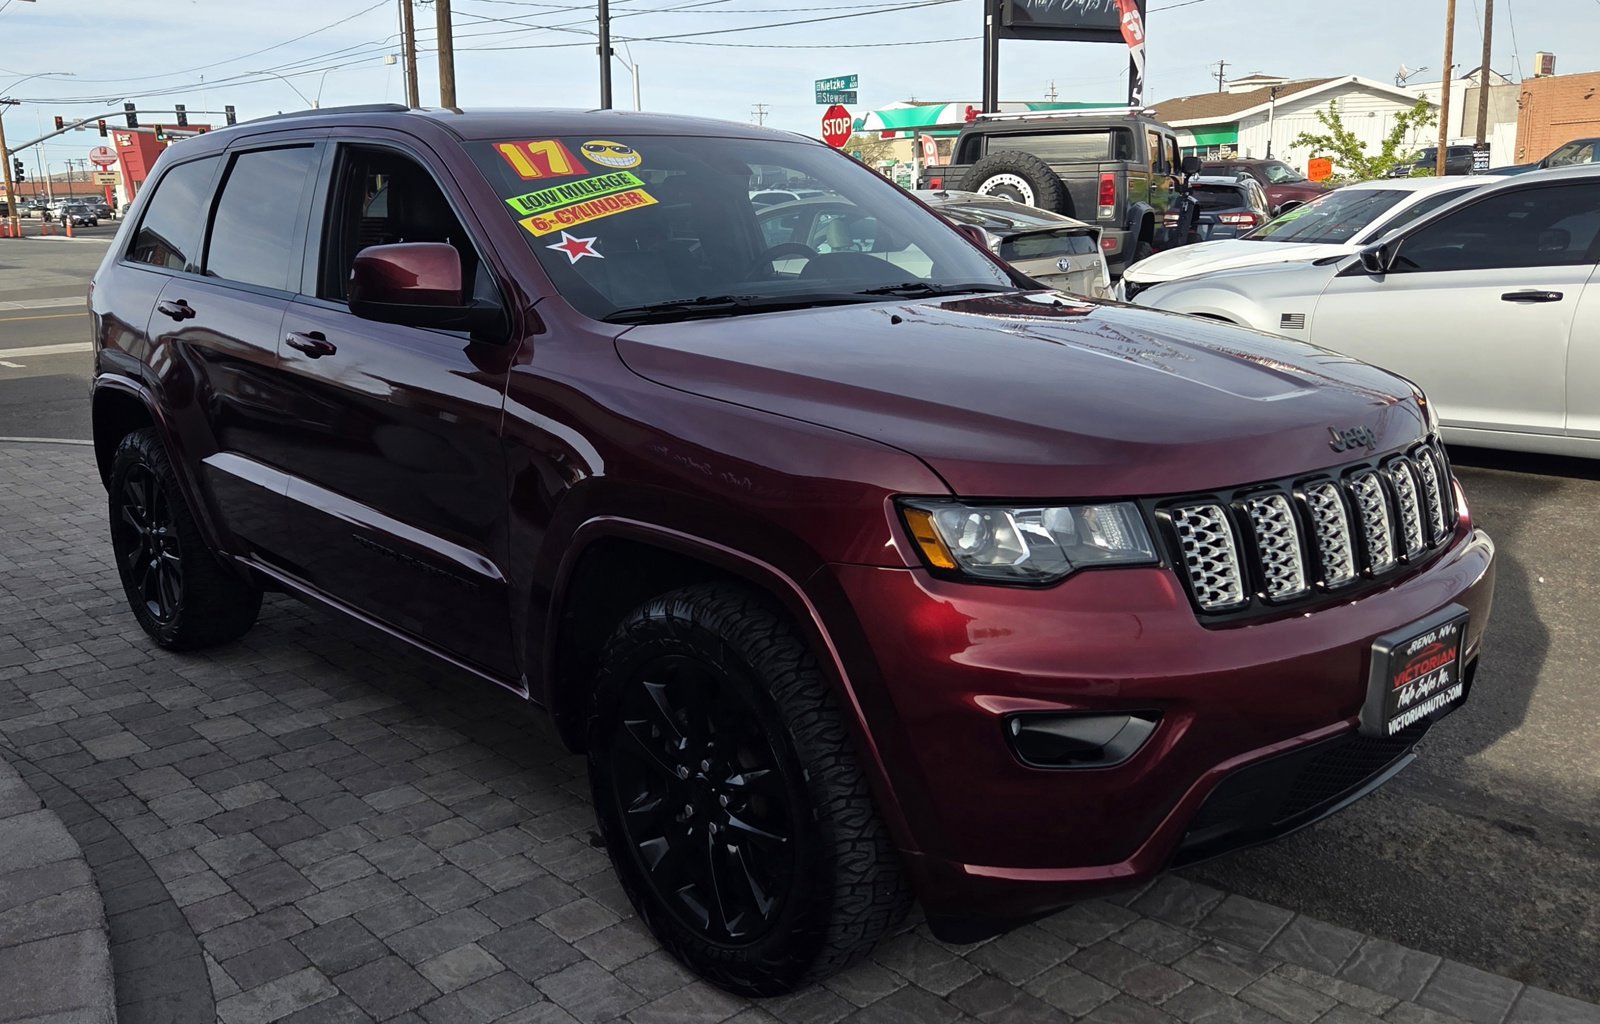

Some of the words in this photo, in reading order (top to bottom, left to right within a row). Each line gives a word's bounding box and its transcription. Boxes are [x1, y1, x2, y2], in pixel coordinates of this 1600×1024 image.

[820, 79, 845, 91] Kietzke
[822, 93, 848, 102] Stewart
[823, 118, 850, 135] STOP
[500, 140, 573, 178] 17
[516, 192, 558, 211] LOW
[557, 172, 632, 200] MILEAGE
[531, 191, 647, 231] 6-CYLINDER
[1328, 425, 1376, 453] Jeep
[1411, 631, 1437, 650] RENO,
[1393, 646, 1456, 687] VICTORIAN
[1397, 685, 1415, 708] Auto
[1415, 674, 1437, 699] Sales
[1388, 682, 1463, 736] VICTORIANAUTO.COM
